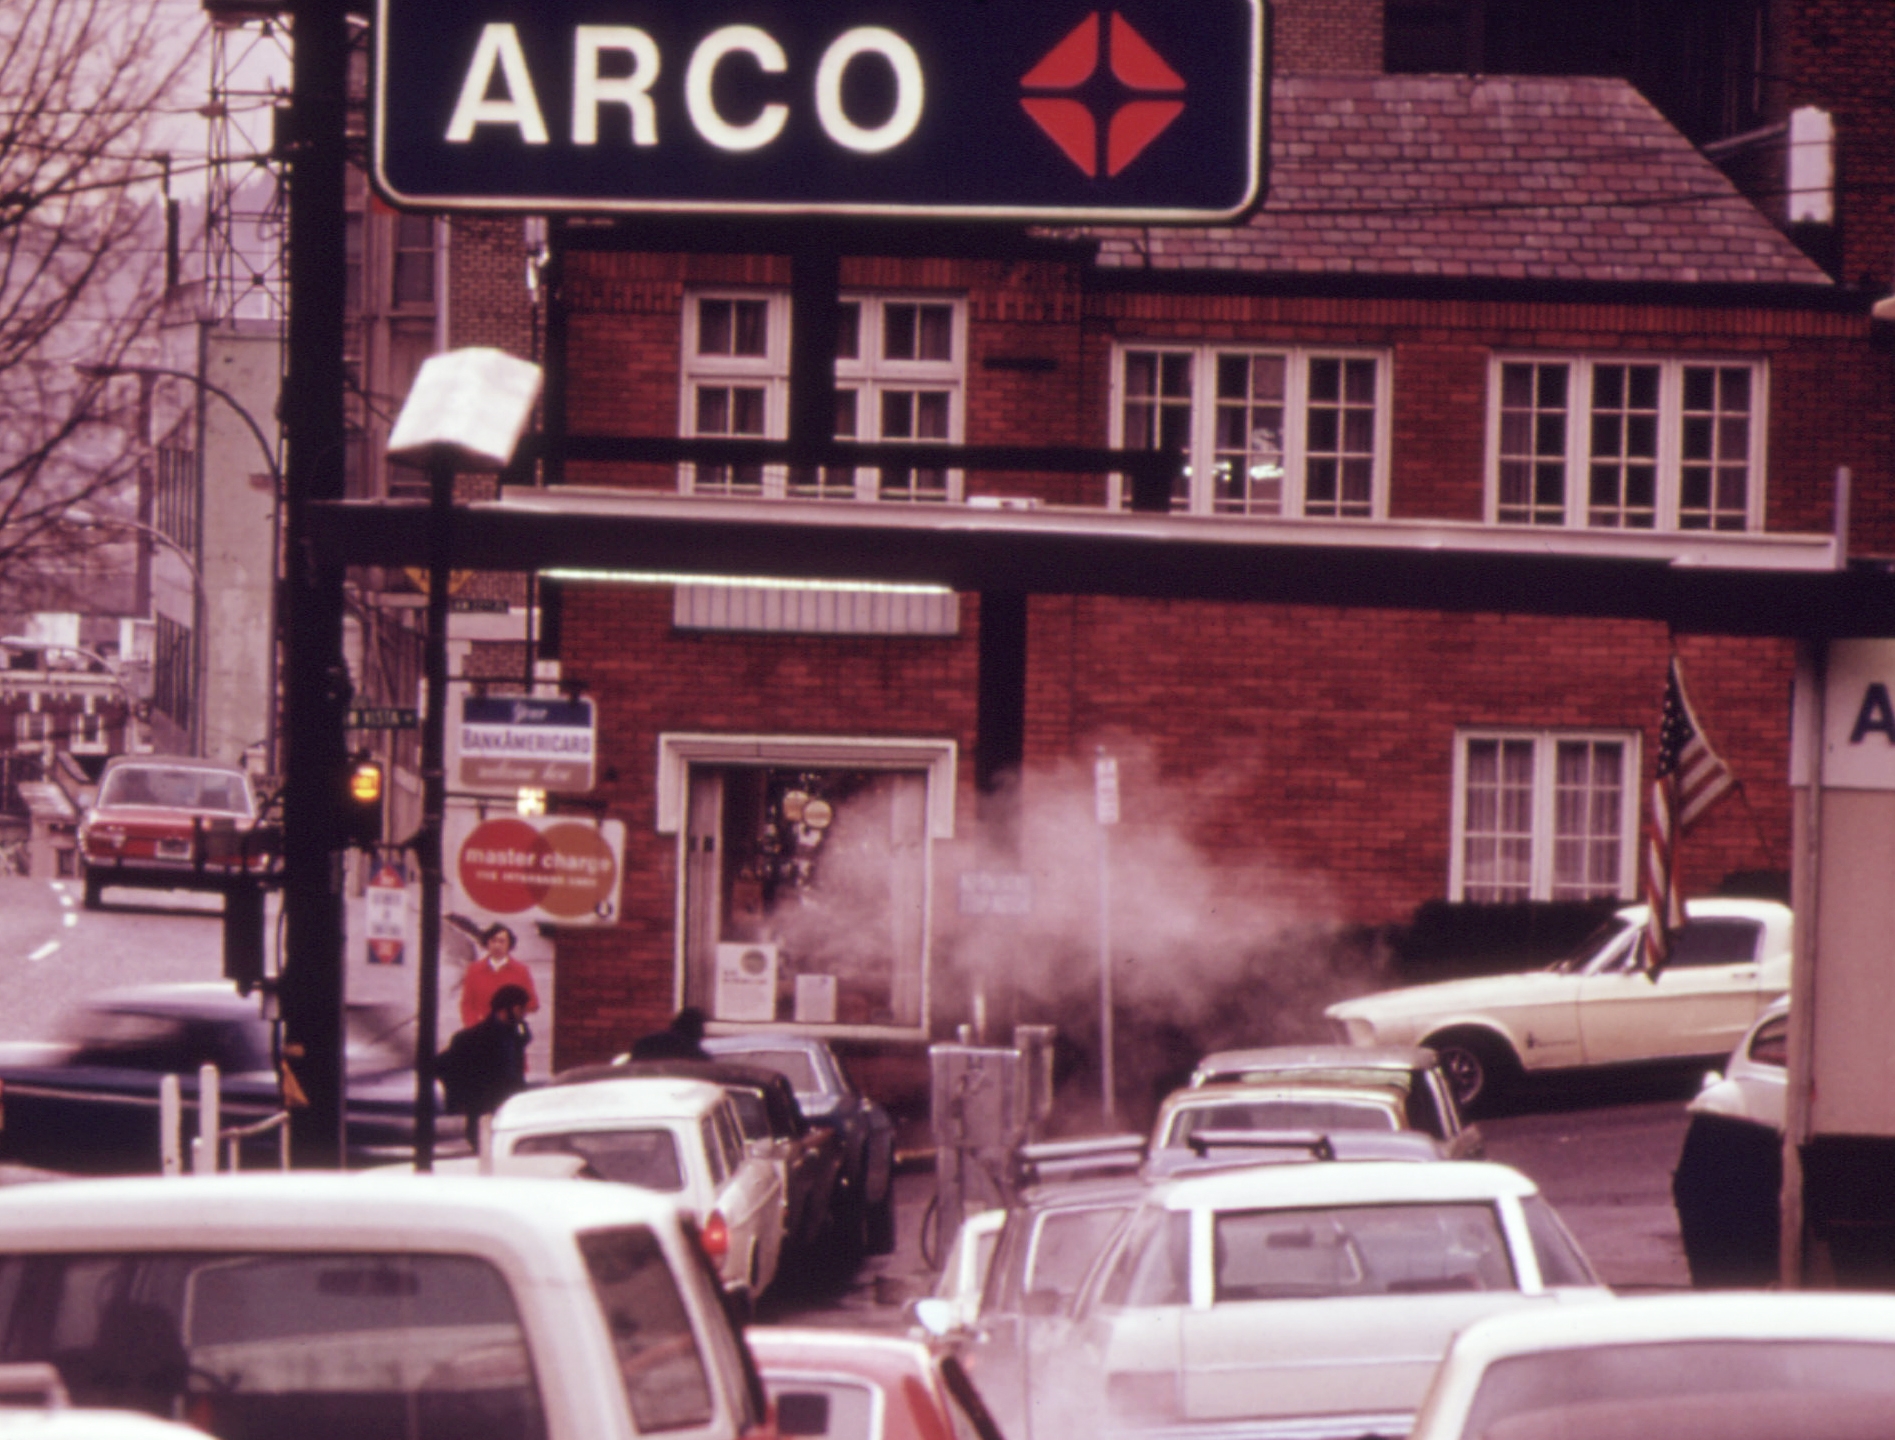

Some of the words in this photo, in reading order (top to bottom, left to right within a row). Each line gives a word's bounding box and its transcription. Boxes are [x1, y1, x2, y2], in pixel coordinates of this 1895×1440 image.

[445, 22, 925, 152] ARCO
[1849, 682, 1895, 745] A
[465, 848, 536, 867] master
[541, 850, 612, 875] charge
